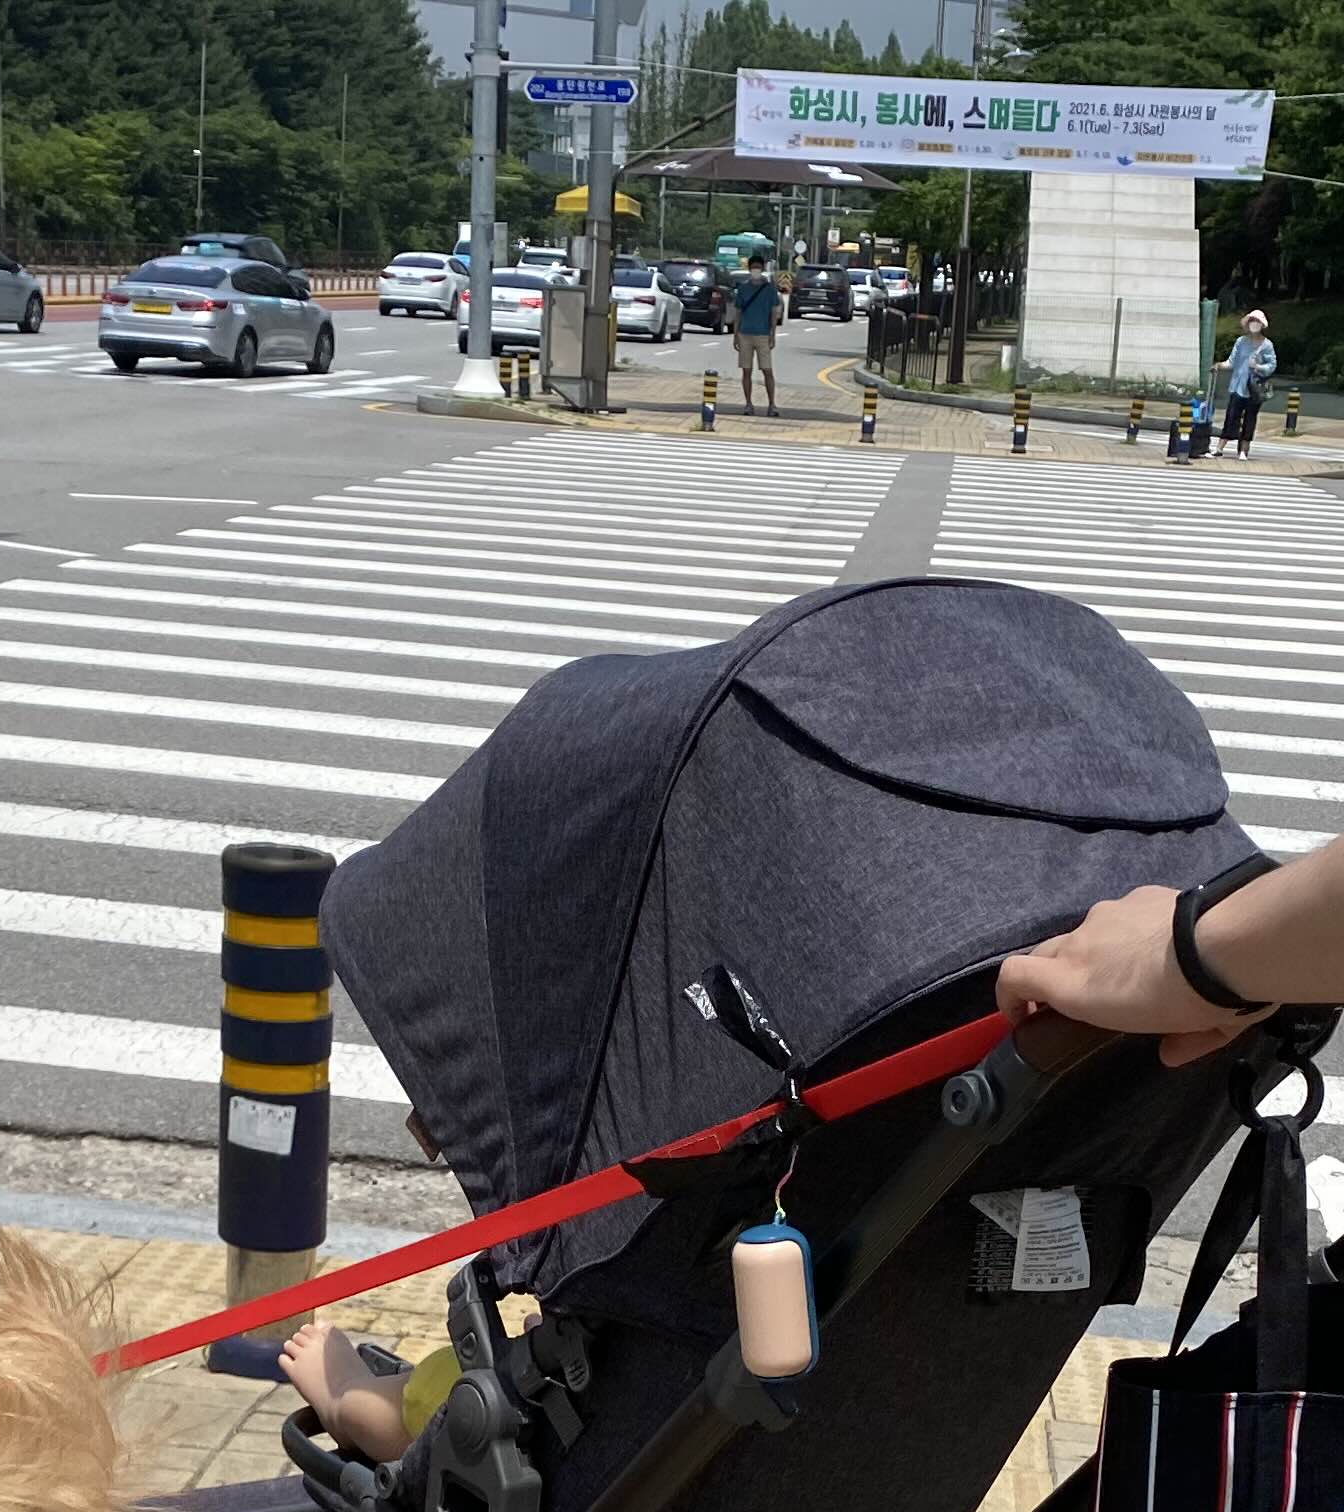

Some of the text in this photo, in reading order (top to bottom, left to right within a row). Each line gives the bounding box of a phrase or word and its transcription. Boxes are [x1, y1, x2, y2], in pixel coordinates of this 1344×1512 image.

[789, 86, 1061, 132] 화성시, 봉사에, 스며들다
[1068, 102, 1217, 121] 2021.6. 화성시 자원봉사의 달
[1067, 119, 1112, 134] 6.1(Tue)
[1122, 121, 1165, 137] 7.3(Sat)
